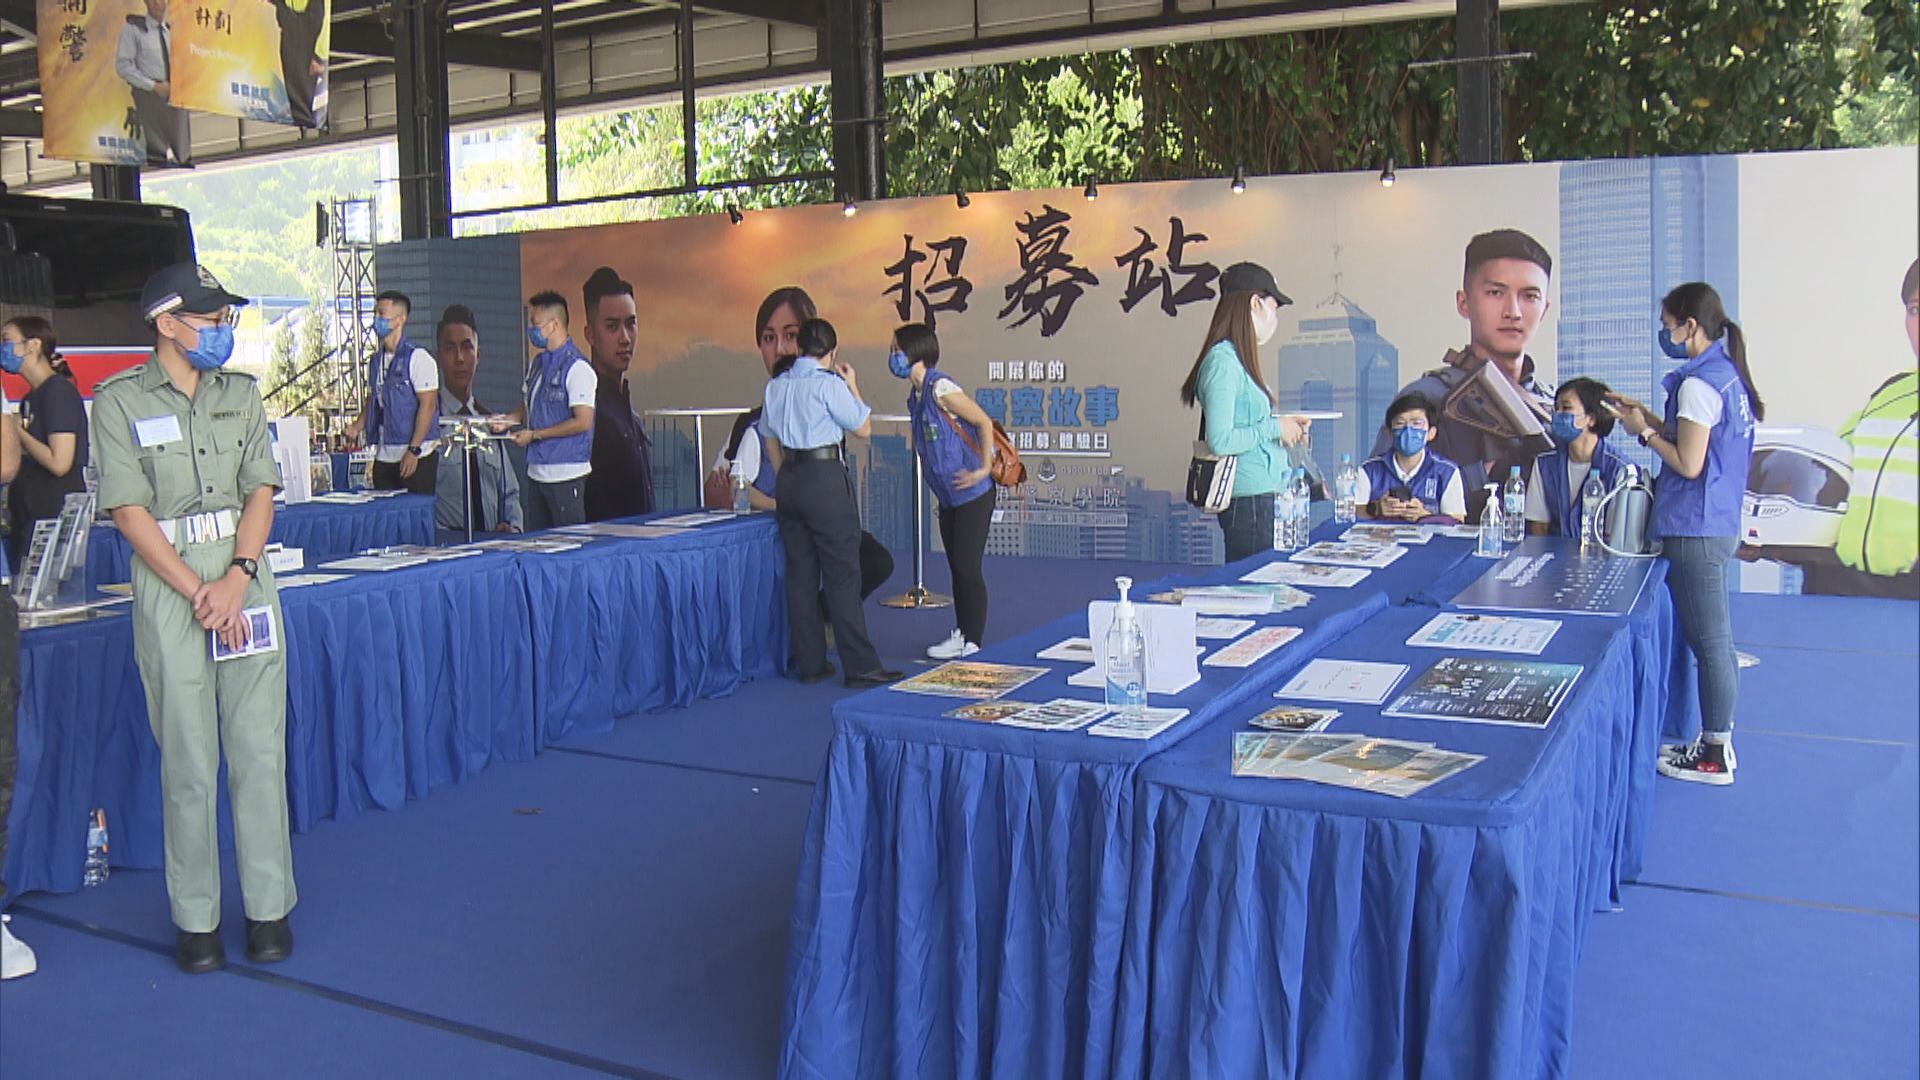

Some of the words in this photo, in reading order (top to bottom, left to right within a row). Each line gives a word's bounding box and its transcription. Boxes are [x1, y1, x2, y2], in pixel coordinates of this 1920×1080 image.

[195, 7, 232, 36] 計劃
[882, 203, 1221, 337] 招募站
[988, 359, 1066, 382] 開展你的
